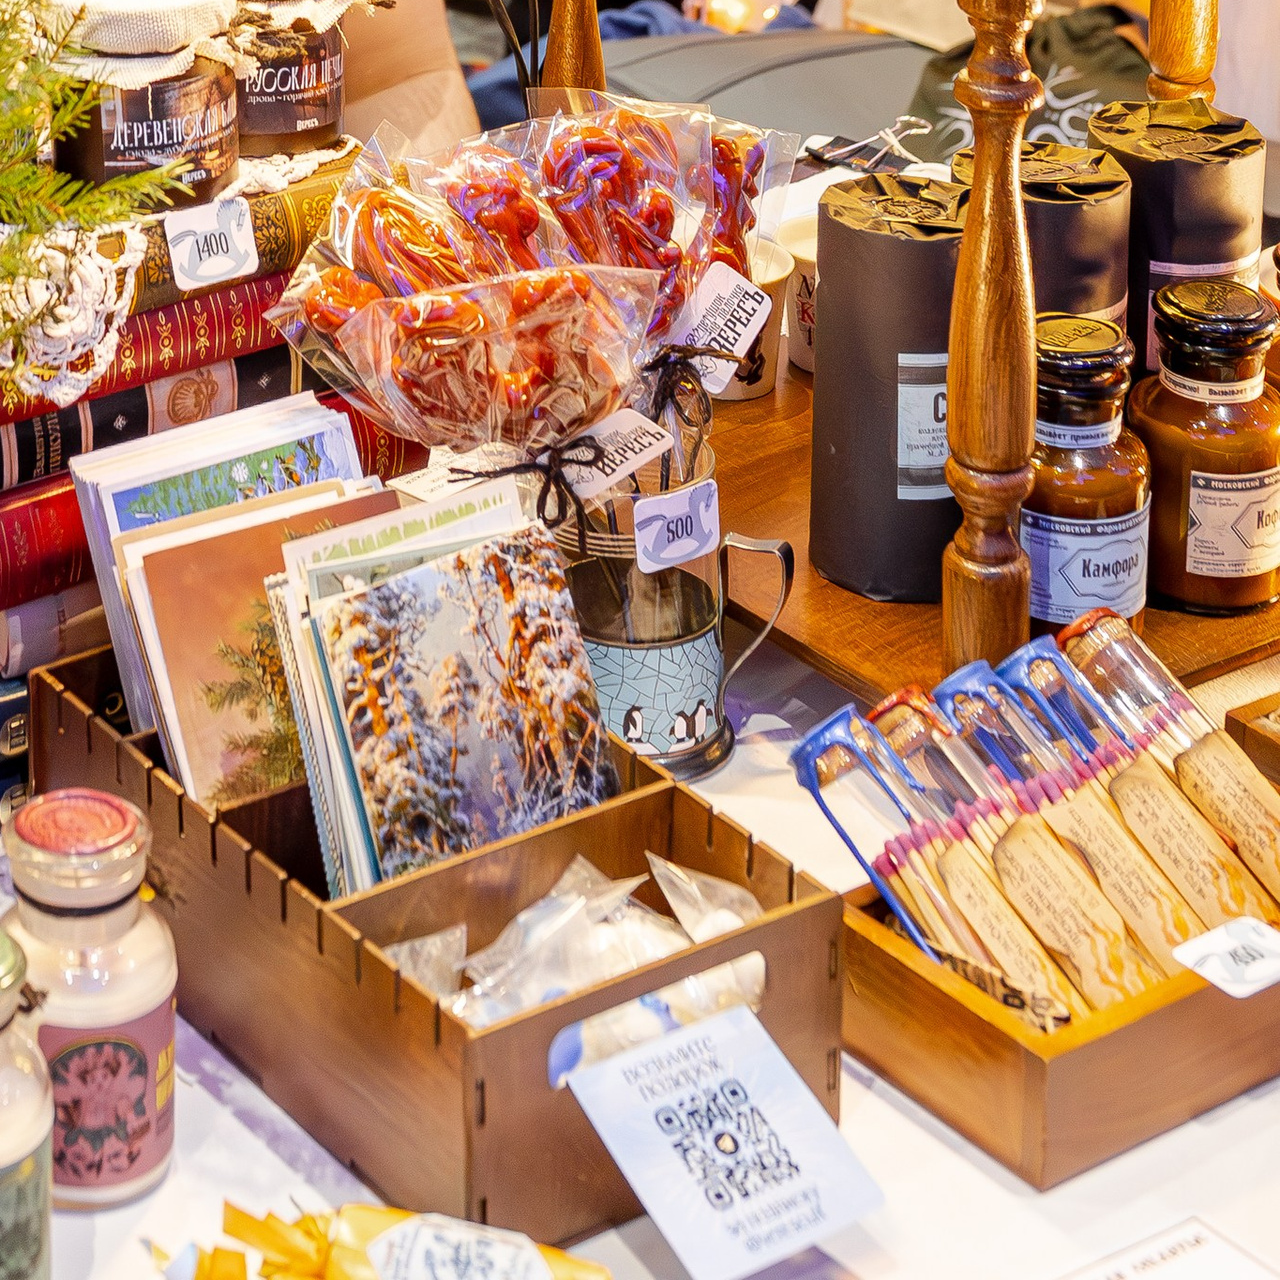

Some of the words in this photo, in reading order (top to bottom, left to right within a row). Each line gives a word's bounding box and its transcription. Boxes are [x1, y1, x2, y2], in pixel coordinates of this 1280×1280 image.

[245, 62, 317, 93] РУССКАЯ
[111, 105, 219, 150] ДЕРЕВЕНСКАЯ
[196, 230, 229, 261] 1400
[666, 514, 694, 543] 500
[1081, 551, 1140, 582] Камфора
